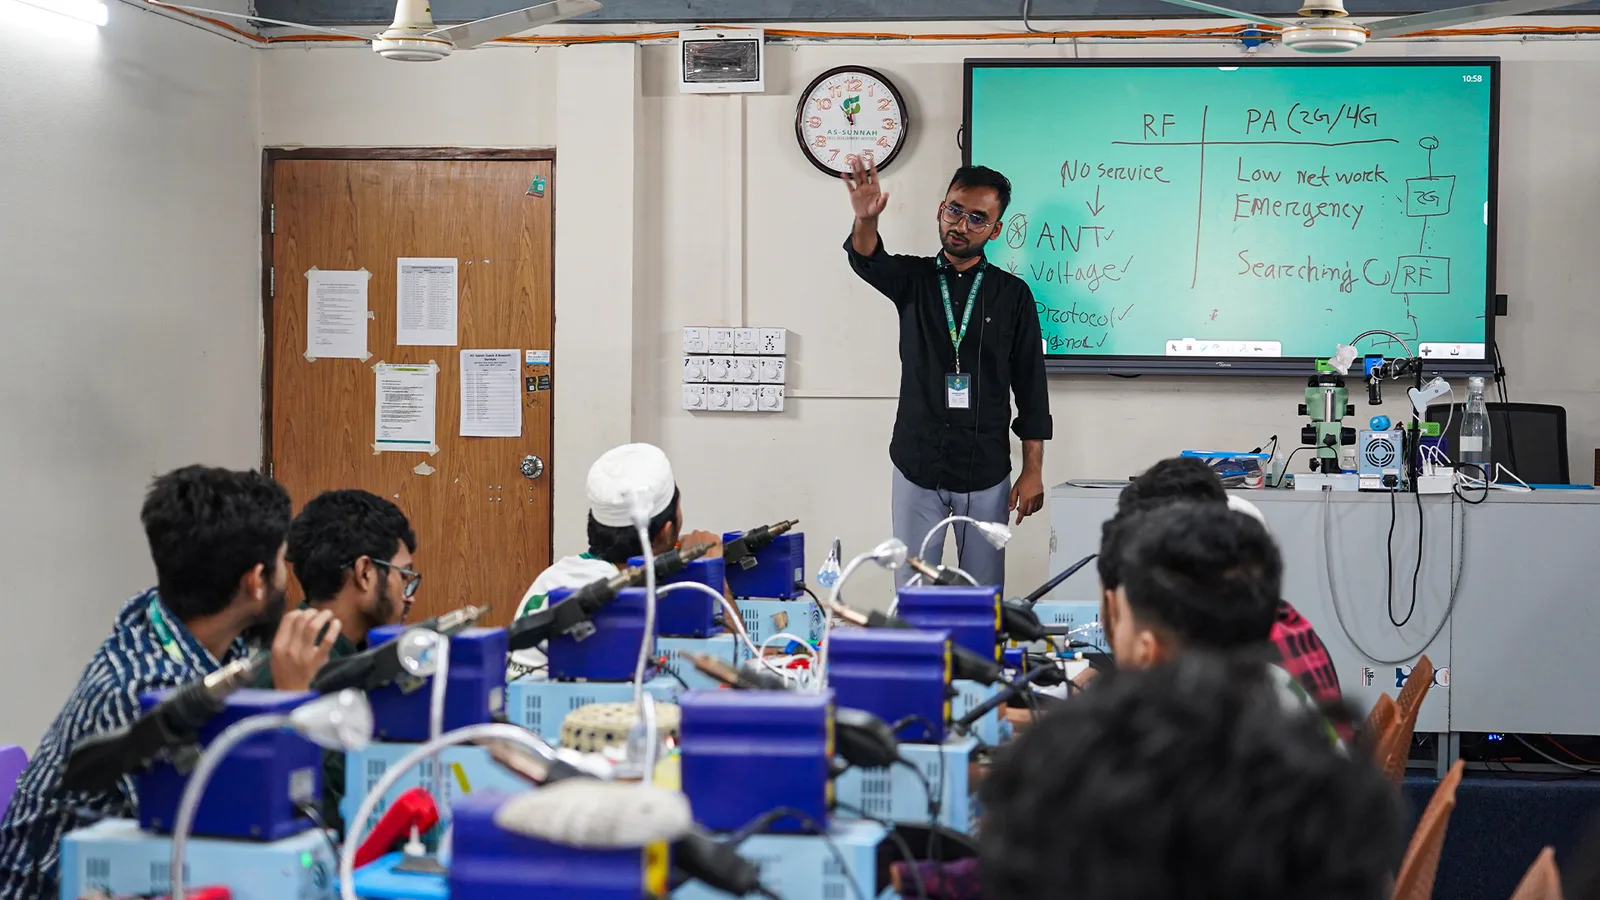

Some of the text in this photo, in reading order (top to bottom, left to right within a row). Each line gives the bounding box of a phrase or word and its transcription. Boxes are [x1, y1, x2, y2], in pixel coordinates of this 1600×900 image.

[844, 79, 862, 92] 12
[1462, 75, 1482, 83] 10:58
[828, 85, 842, 98] 11
[868, 84, 874, 97] 1
[815, 98, 832, 111] 10
[877, 98, 890, 111] 2
[808, 116, 822, 129] 9
[882, 118, 894, 130] 3
[1246, 103, 1377, 135] PA (2G/4G
[1143, 113, 1176, 140] RF
[814, 135, 827, 148] 8
[876, 136, 888, 148] 4
[829, 149, 840, 161] 7
[862, 149, 874, 161] 5
[1097, 163, 1170, 183] service
[1237, 157, 1281, 182] Low
[1036, 222, 1105, 252] ANT
[1030, 261, 1121, 293] Voltage
[1238, 250, 1359, 294] Searching
[1403, 265, 1433, 287] RF
